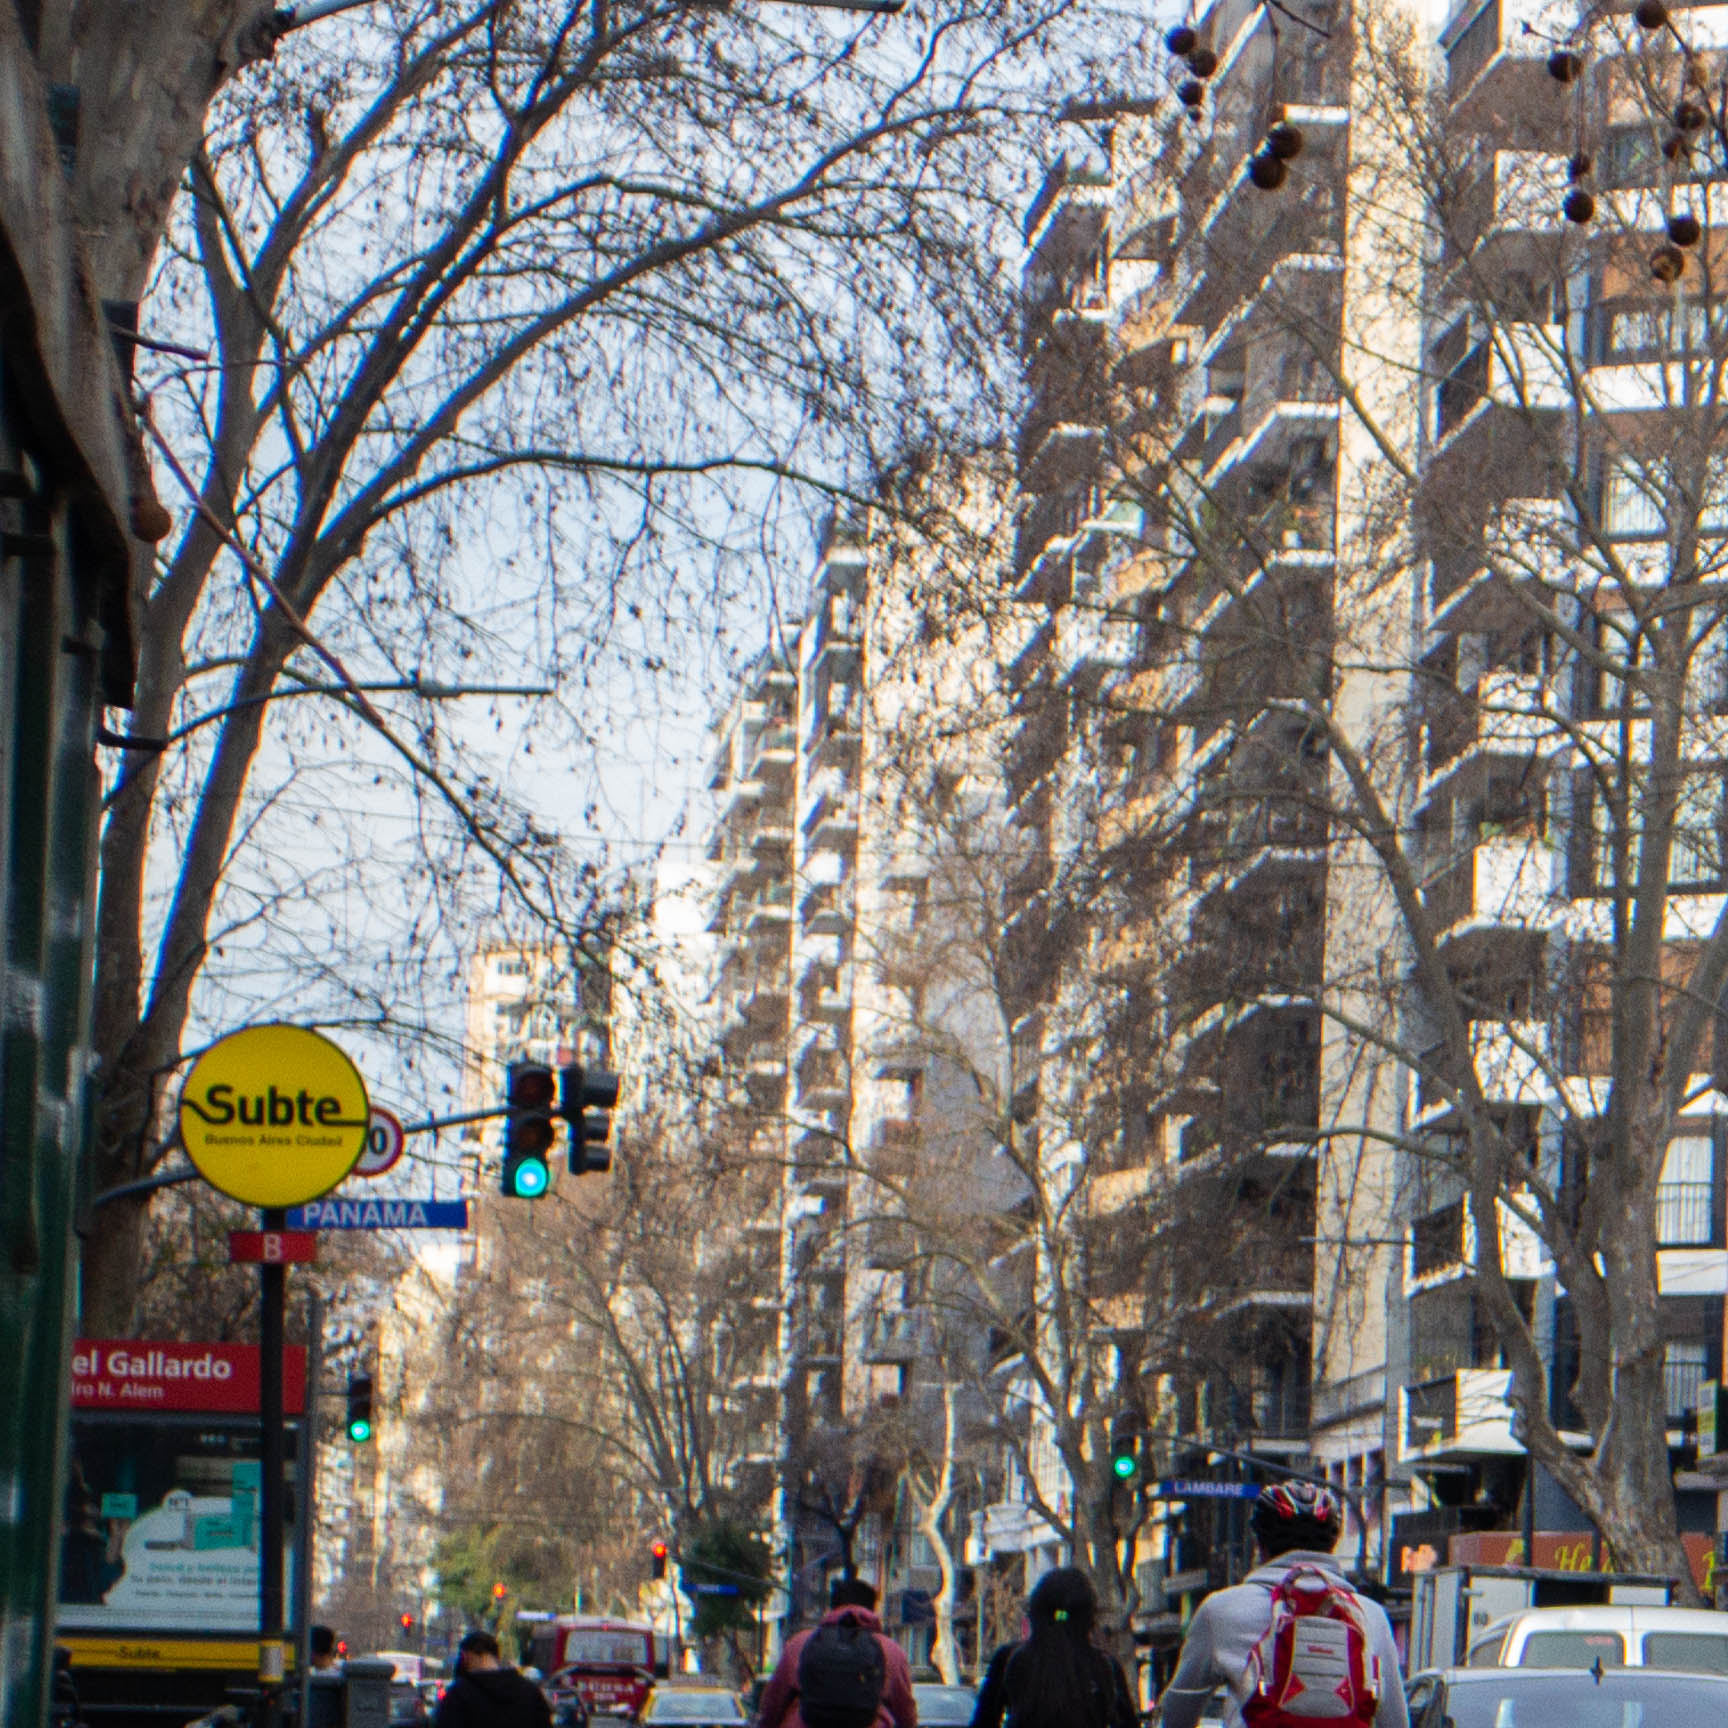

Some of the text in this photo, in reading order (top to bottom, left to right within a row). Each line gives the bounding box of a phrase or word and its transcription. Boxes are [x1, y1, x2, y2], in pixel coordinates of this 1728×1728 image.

[205, 1084, 343, 1126] Subte
[259, 1135, 292, 1146] Aires
[370, 1126, 388, 1155] 0
[304, 1202, 428, 1225] PANAMA
[263, 1233, 282, 1259] B
[107, 1351, 232, 1381] Gallardo
[121, 1382, 164, 1399] Alem
